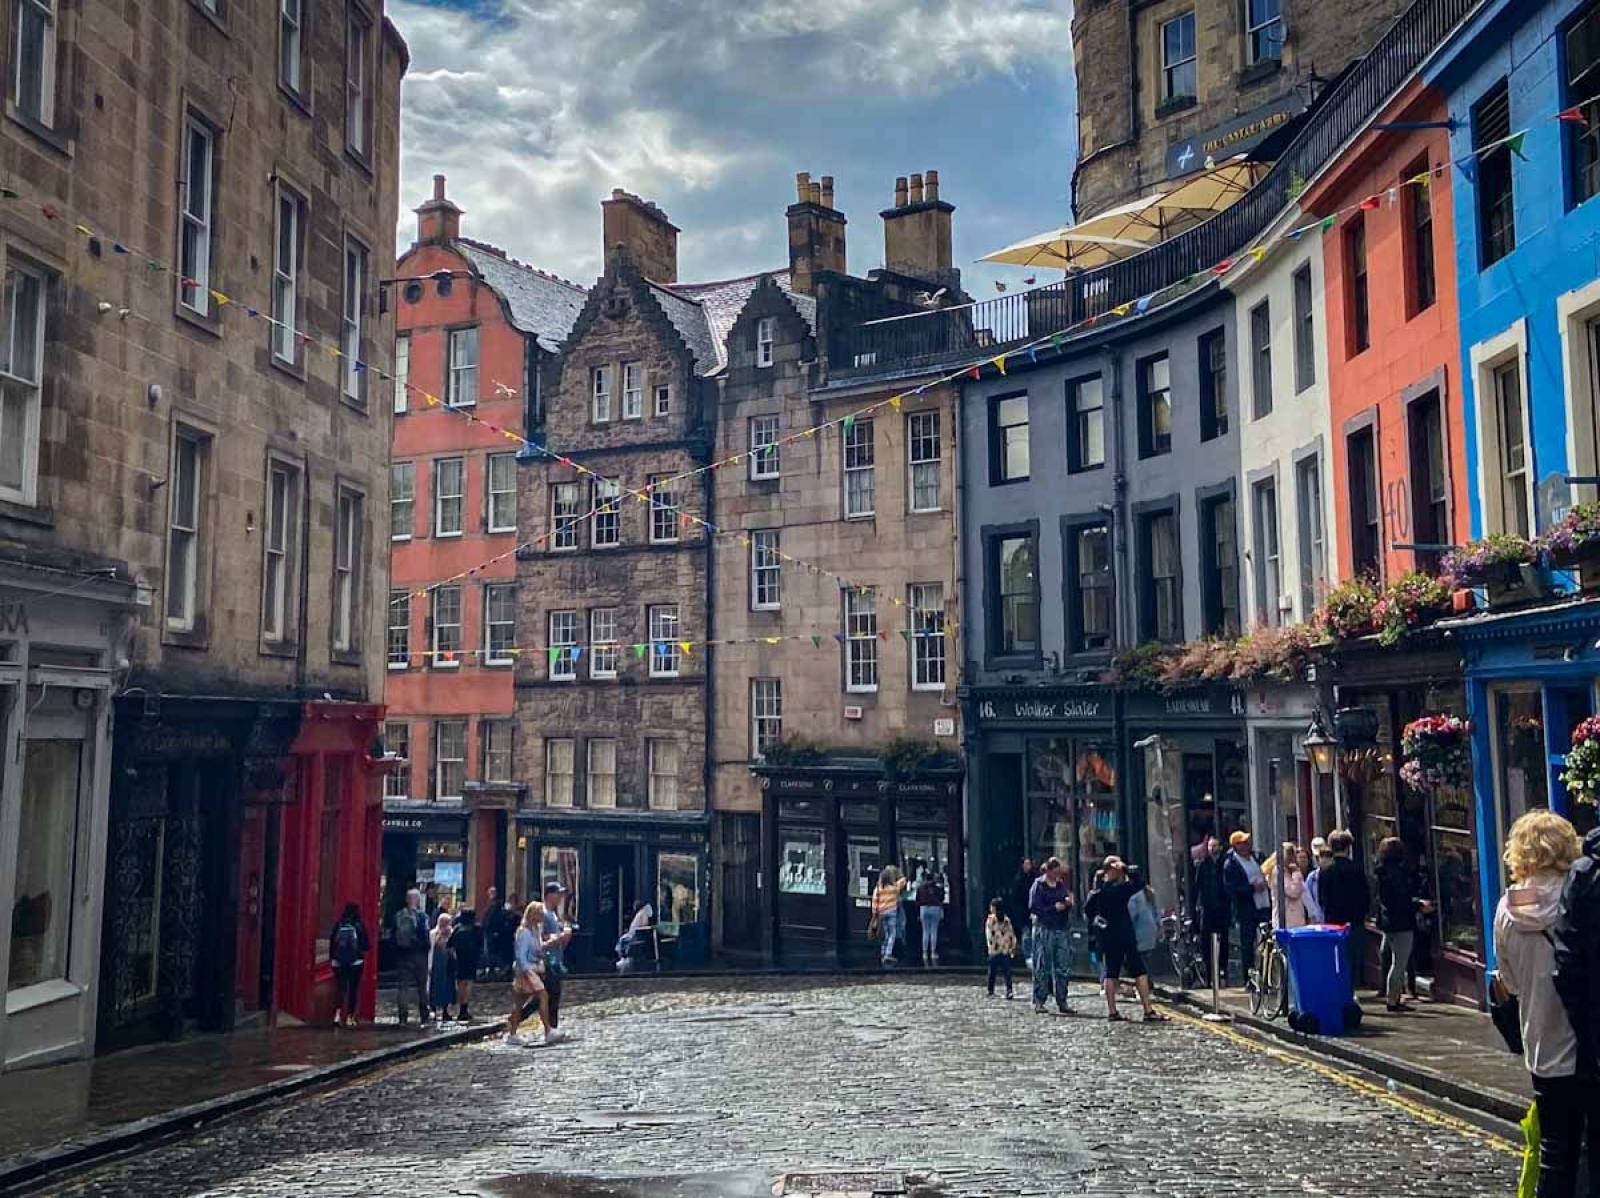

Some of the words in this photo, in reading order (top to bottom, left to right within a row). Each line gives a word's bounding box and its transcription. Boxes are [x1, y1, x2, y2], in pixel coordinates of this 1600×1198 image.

[1383, 480, 1409, 541] 40
[1015, 702, 1057, 717] Walker
[1063, 699, 1100, 717] Slater
